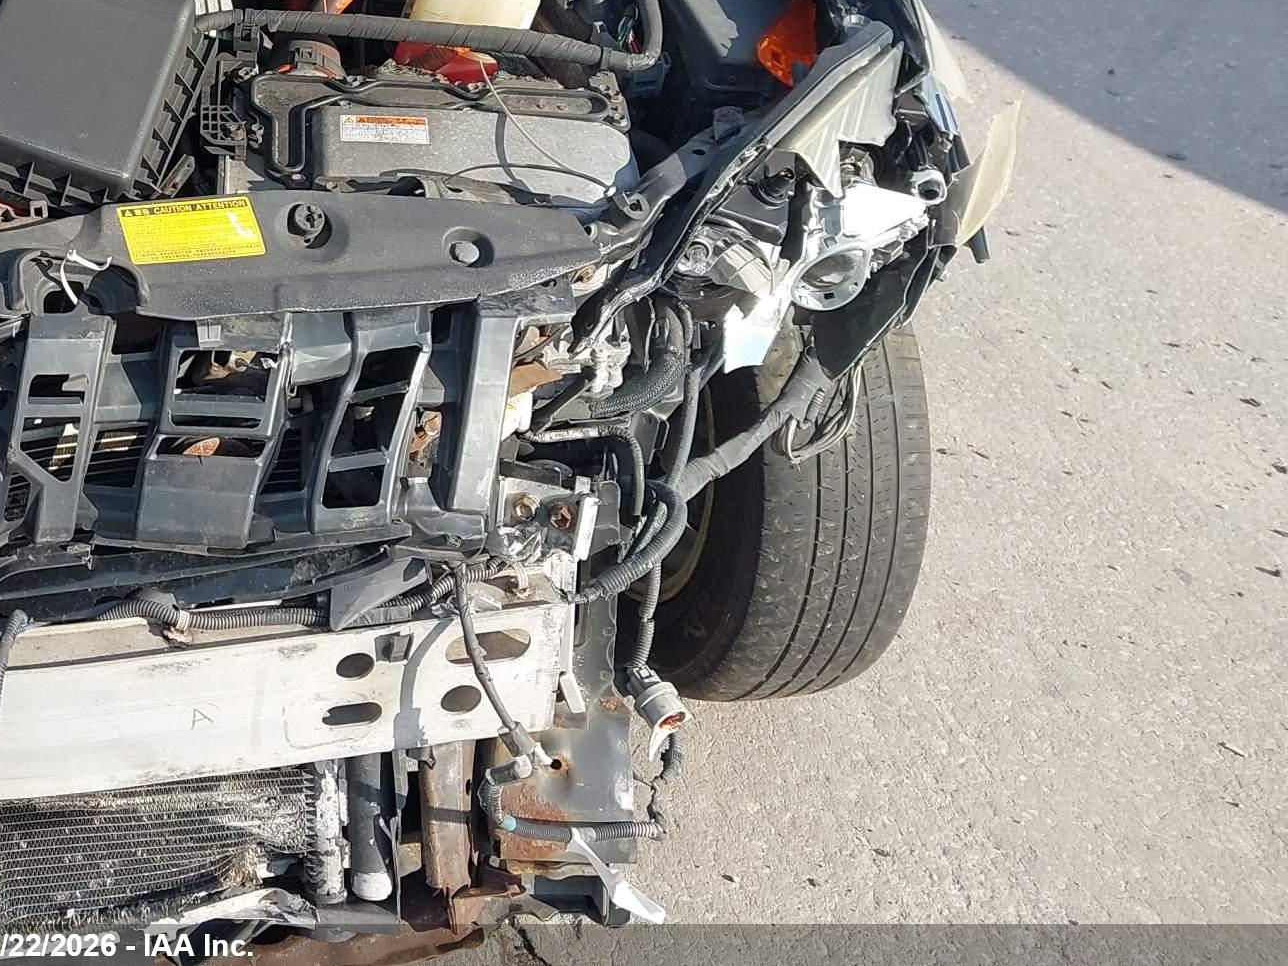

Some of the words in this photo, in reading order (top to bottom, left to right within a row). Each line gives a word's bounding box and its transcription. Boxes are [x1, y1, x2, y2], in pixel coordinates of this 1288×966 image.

[153, 204, 192, 214] CAUTION
[196, 200, 246, 210] ATTENTION
[190, 708, 214, 730] A
